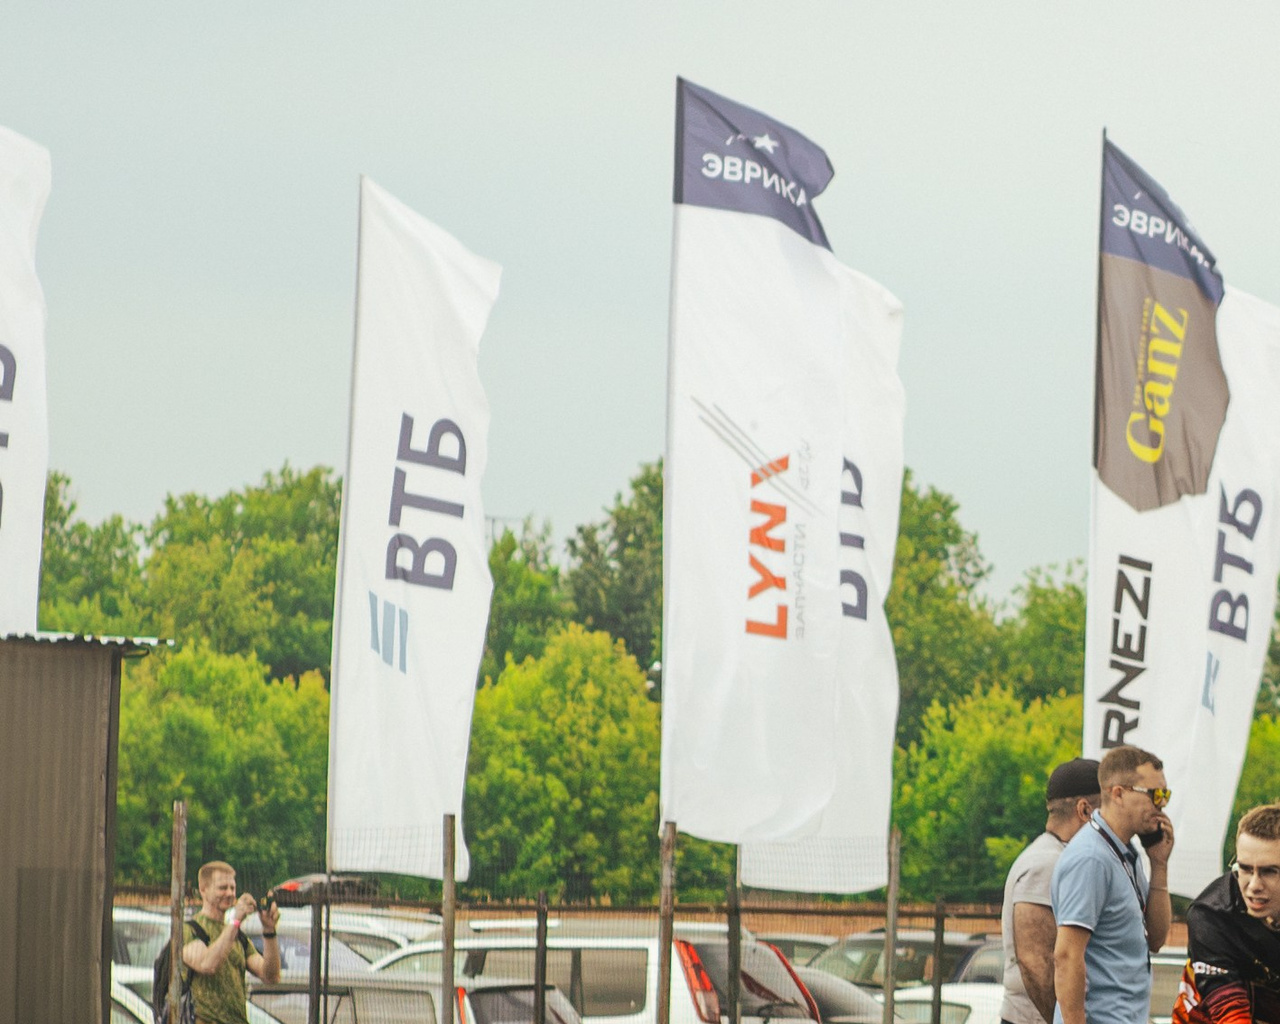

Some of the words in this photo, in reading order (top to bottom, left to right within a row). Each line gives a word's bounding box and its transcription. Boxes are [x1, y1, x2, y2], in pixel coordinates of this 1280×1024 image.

[702, 153, 807, 207] ЭВРИКА
[1126, 302, 1189, 463] Ganz
[385, 412, 467, 591] ВТБ
[745, 454, 791, 640] LYNX
[1209, 481, 1264, 643] ВТБ
[1097, 554, 1152, 750] RNEZI
